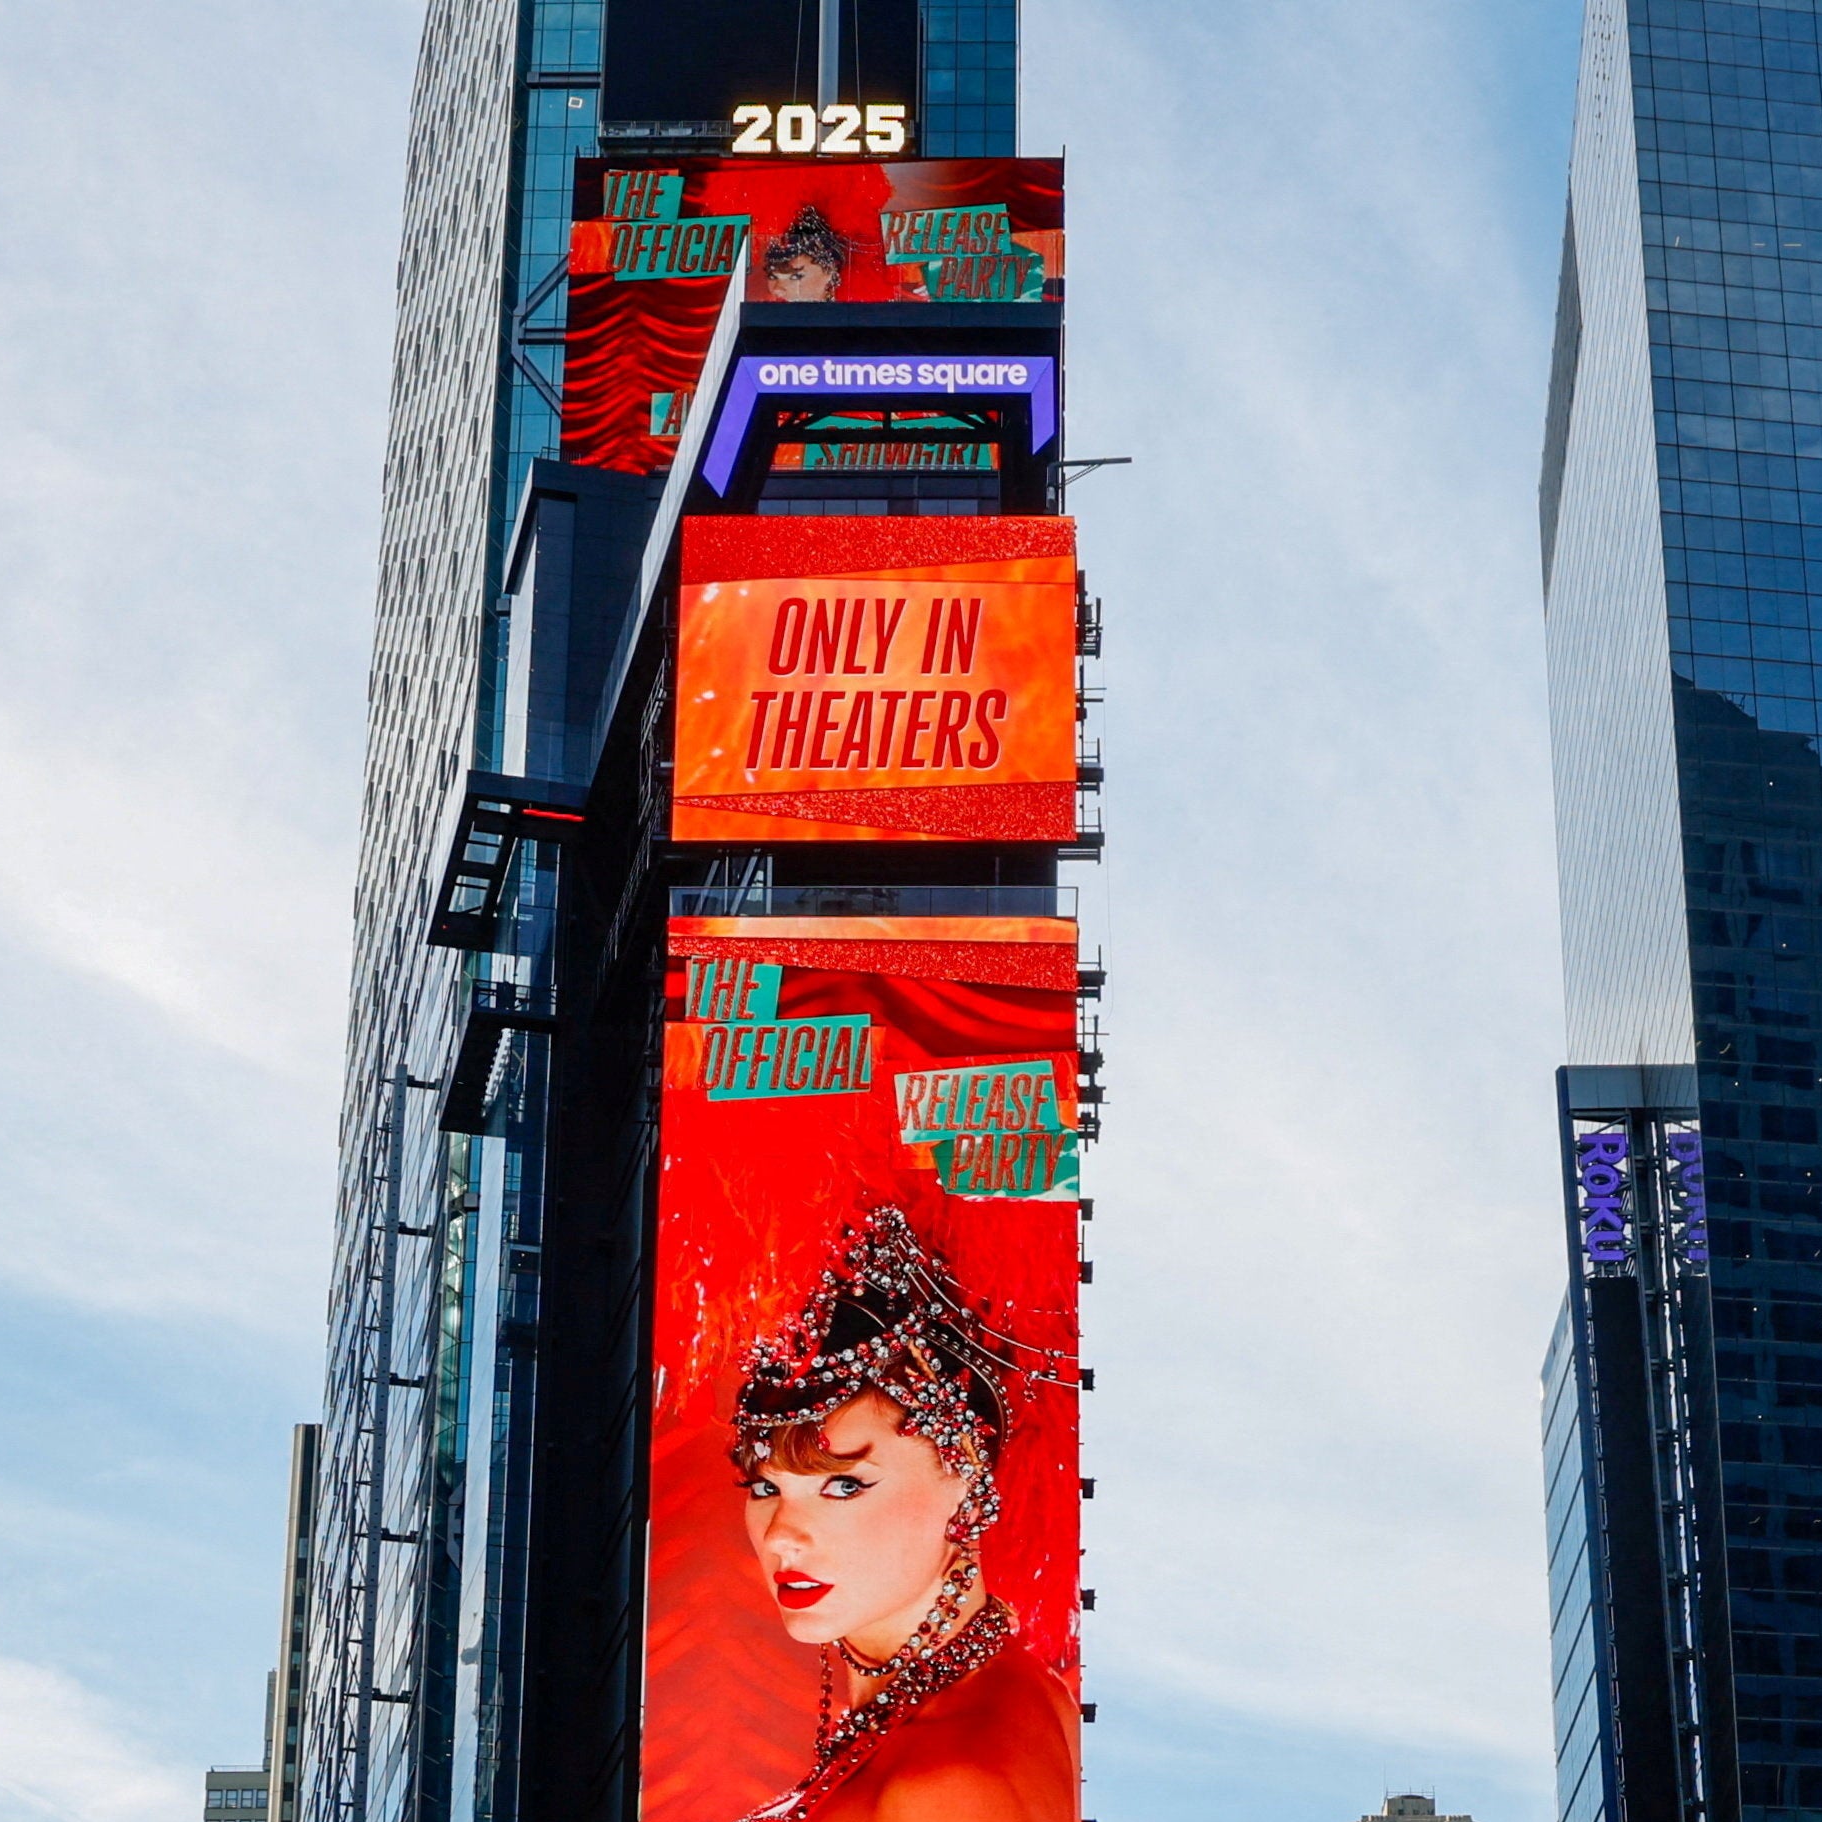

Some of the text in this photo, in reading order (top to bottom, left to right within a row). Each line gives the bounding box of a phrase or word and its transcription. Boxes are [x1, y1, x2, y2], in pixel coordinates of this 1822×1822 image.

[732, 105, 906, 152] 2025
[603, 171, 665, 218] THE
[885, 211, 1008, 254] RELEASE
[936, 256, 1029, 298] PARTY
[759, 360, 1027, 393] one times square
[768, 599, 979, 674] ONLY IN
[746, 689, 1008, 770] THEATERS
[691, 957, 761, 1020] THE
[697, 1026, 871, 1090] OFFICIAL
[899, 1073, 1053, 1131] RELEASE
[948, 1133, 1064, 1190] PARTY
